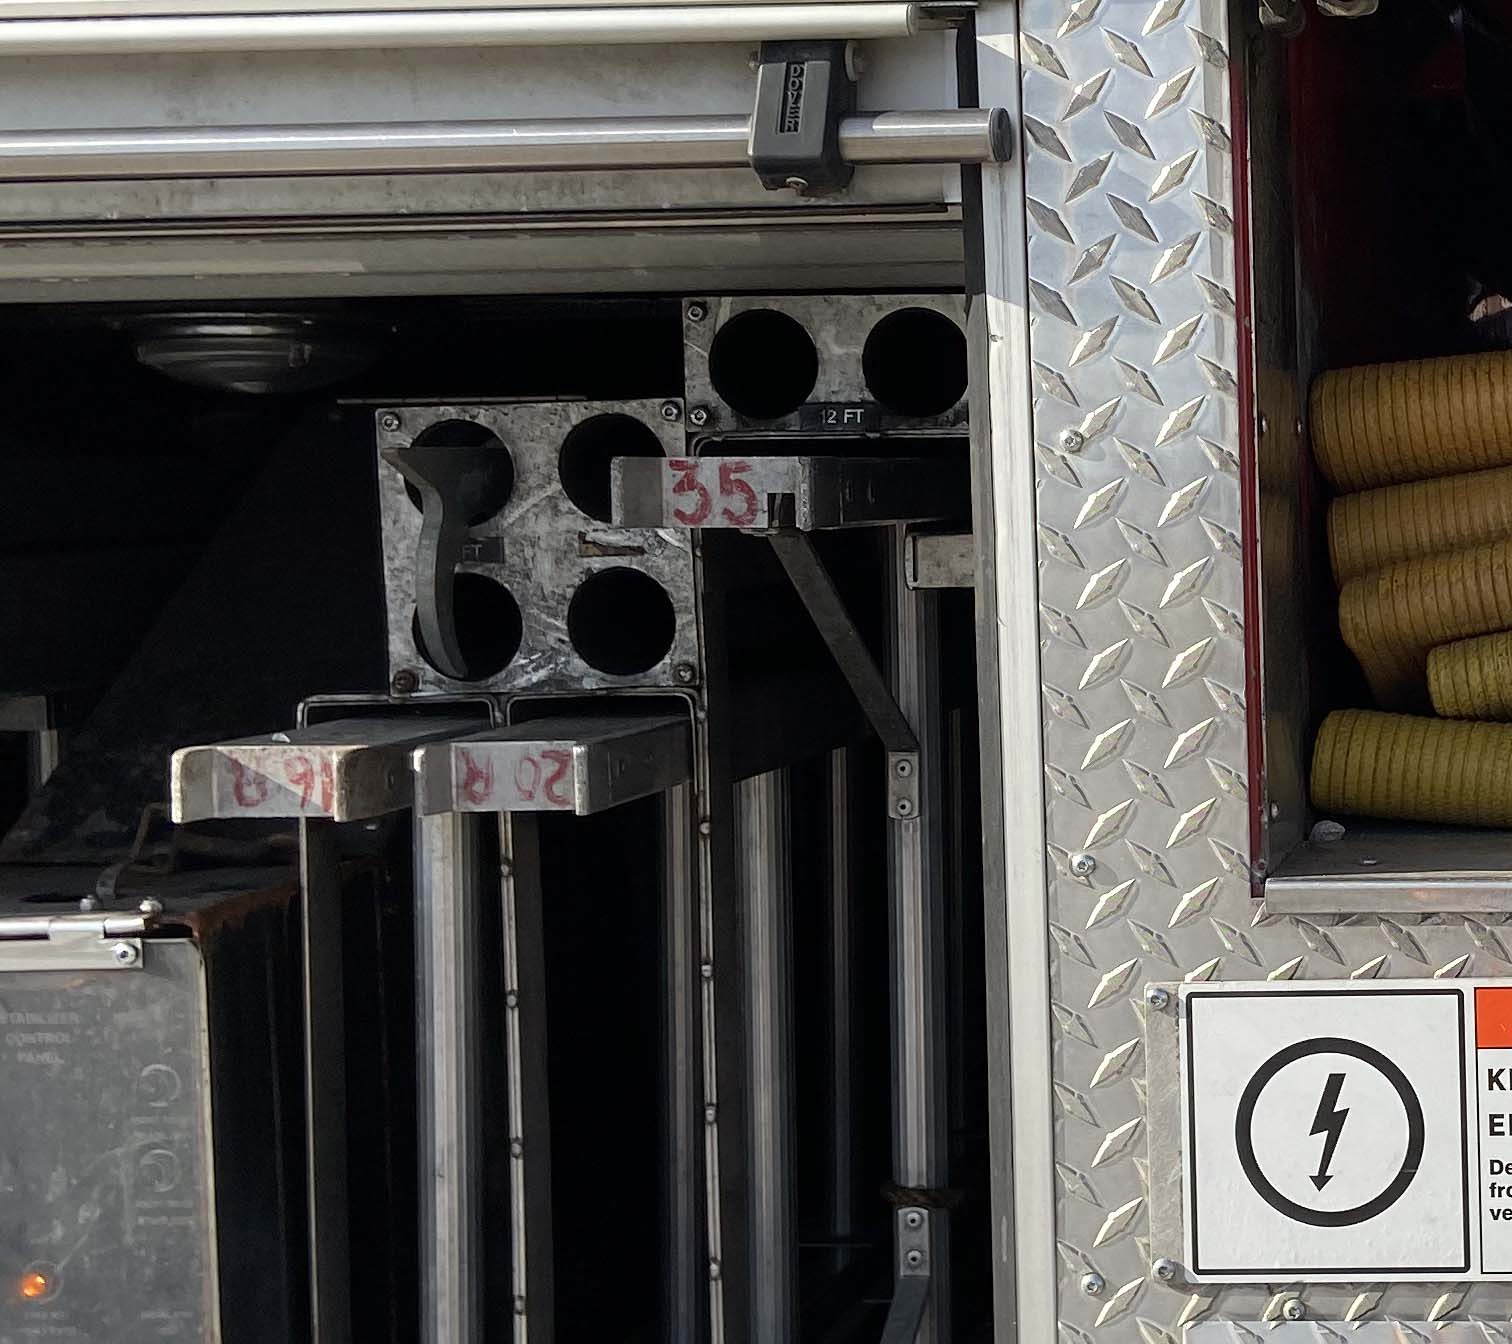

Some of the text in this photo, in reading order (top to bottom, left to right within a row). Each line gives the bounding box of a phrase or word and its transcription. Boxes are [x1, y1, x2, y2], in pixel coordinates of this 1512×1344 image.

[785, 64, 803, 133] DOVER
[844, 409, 865, 424] FT
[668, 459, 758, 527] 35
